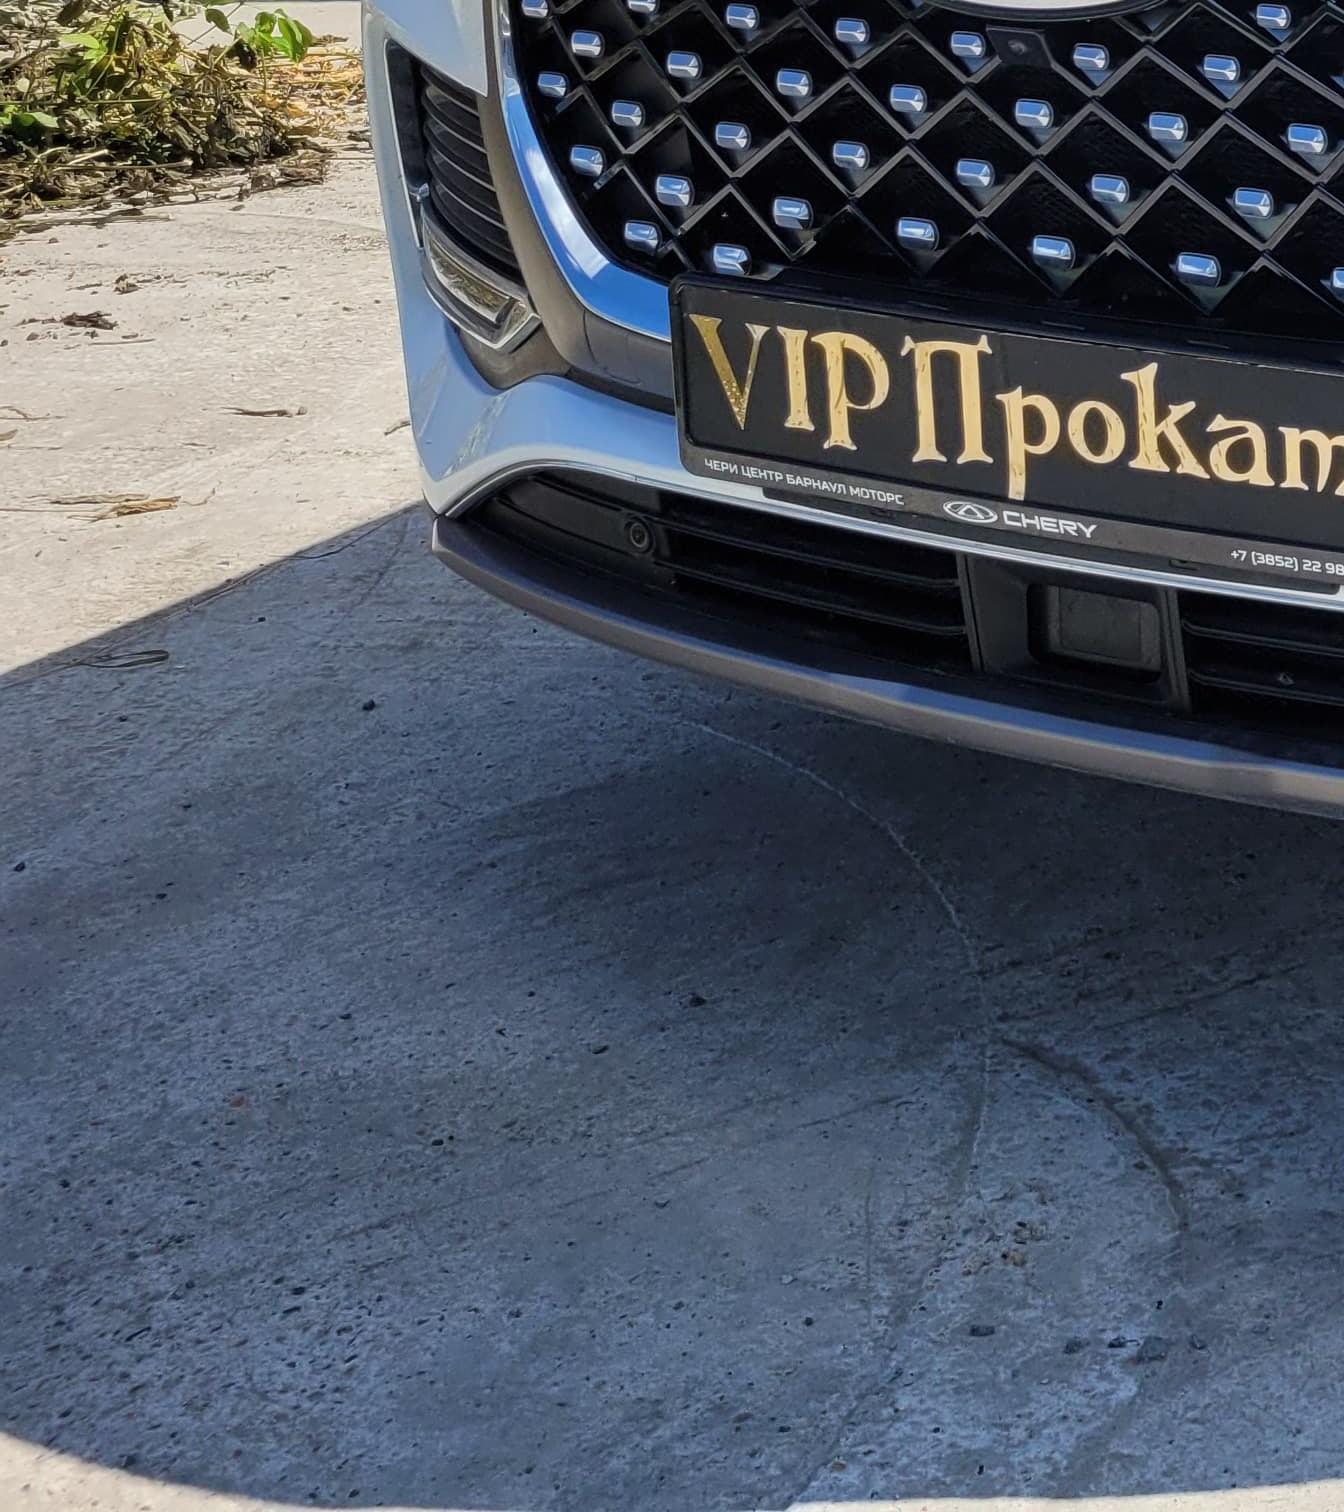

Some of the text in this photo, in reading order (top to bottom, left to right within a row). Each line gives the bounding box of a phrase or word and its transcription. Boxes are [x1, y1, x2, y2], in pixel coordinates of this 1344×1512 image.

[688, 313, 891, 451] VIP
[704, 458, 905, 506] ЧЕРИ ЦЕНТР БАРНАУЛ МОТОРС
[1003, 510, 1097, 538] CHERY
[1231, 549, 1247, 561] +7
[1251, 551, 1299, 572] (3852)
[1302, 559, 1322, 573] 22
